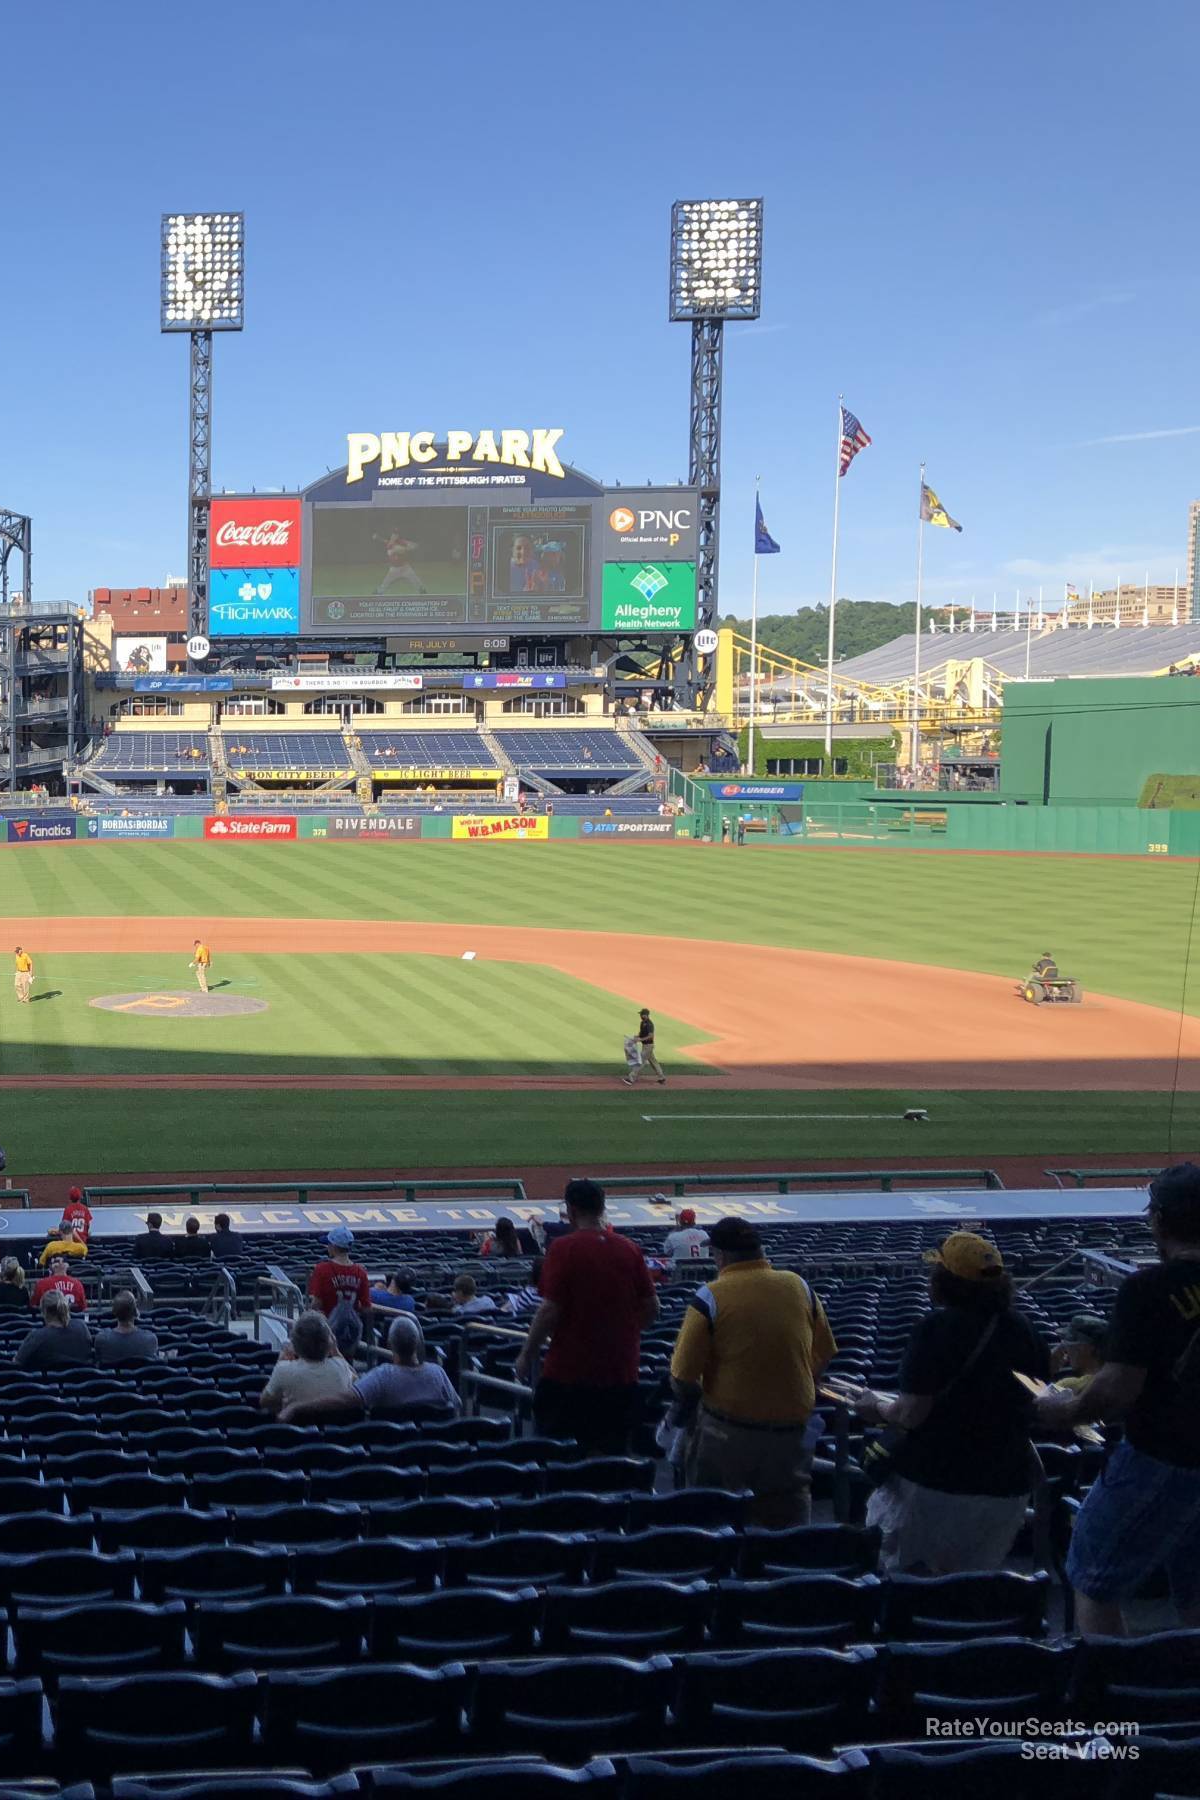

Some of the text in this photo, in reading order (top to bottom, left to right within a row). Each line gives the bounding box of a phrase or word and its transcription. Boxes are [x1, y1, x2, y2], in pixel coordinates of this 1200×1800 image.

[346, 429, 565, 484] PNC PARK
[378, 475, 526, 486] HOME OF THE PITTSBURGH PIRATES
[638, 510, 691, 529] PNC
[220, 607, 294, 620] HIGHMARK
[615, 604, 682, 619] Allegheny
[614, 619, 680, 628] Health Network
[190, 641, 208, 653] Lite
[426, 640, 448, 649] JULY
[483, 639, 507, 648] 6:09
[698, 635, 716, 647] Lite
[276, 771, 303, 779] CITY
[412, 770, 446, 778] LIGHT
[449, 770, 471, 778] BEER
[740, 786, 785, 794] LUMBER
[335, 818, 414, 830] RIVENDALE
[594, 823, 672, 832] AT&T SPORTSNET
[30, 824, 72, 838] Fanatics
[1148, 843, 1168, 852] 399
[437, 1208, 496, 1221] TO
[506, 1202, 632, 1220] PC
[54, 1280, 74, 1292] UTLEY
